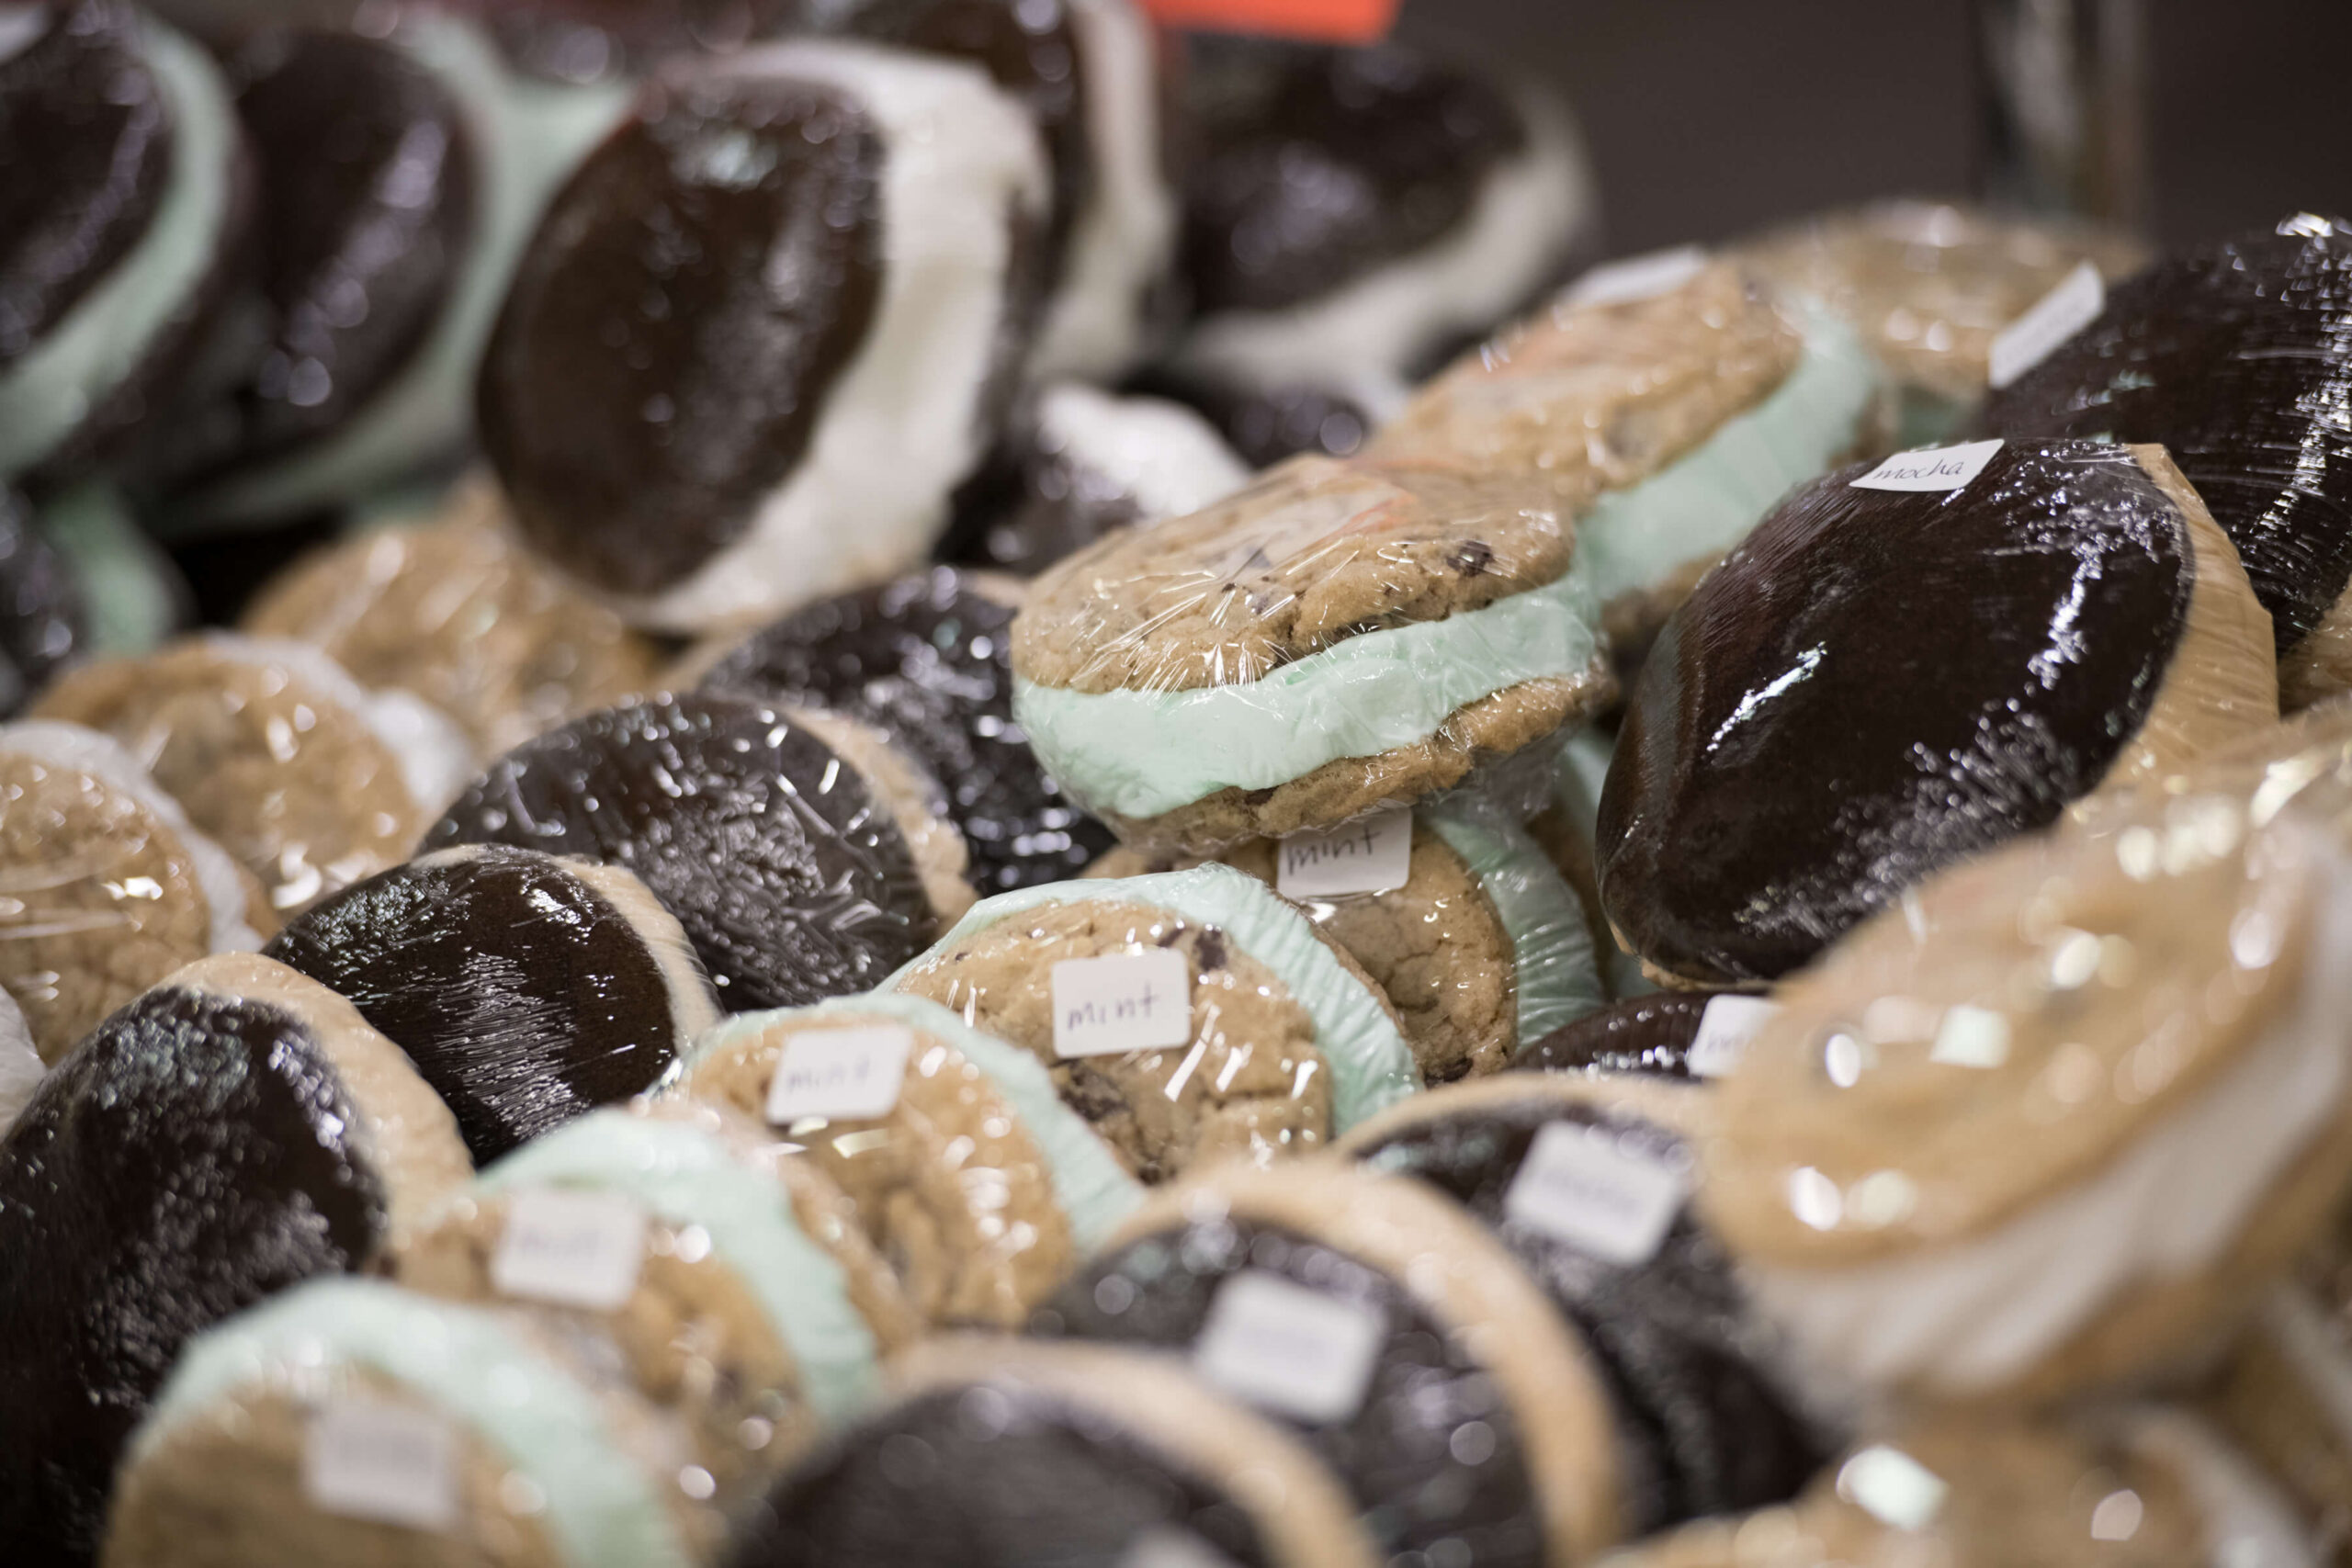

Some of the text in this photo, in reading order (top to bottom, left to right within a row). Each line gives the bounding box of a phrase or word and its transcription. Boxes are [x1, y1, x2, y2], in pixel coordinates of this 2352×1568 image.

[1872, 458, 1964, 480] mocha
[1287, 828, 1382, 876] mint
[1068, 980, 1160, 1032] mint
